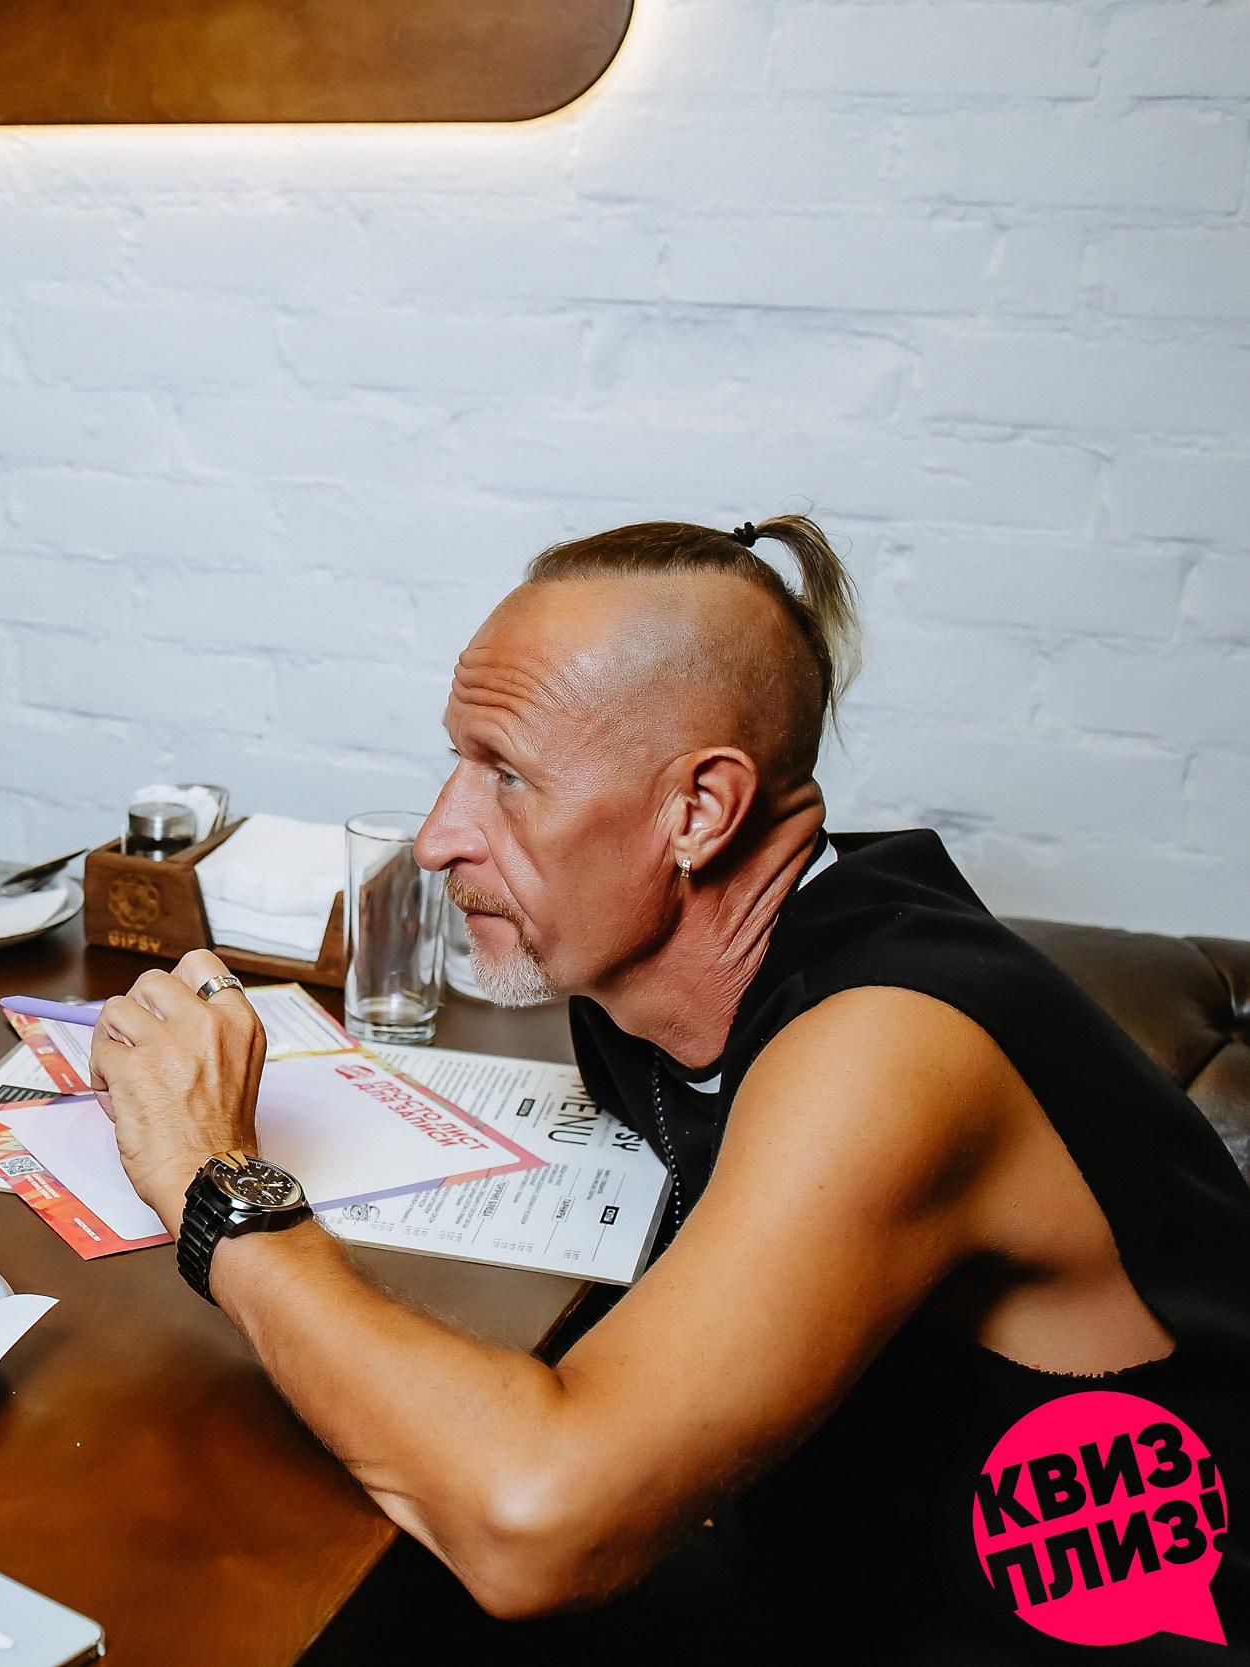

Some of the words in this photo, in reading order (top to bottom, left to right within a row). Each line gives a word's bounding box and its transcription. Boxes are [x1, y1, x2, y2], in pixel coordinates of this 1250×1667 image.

[352, 1083, 395, 1103] ДЛЯ
[388, 1104, 459, 1147] ЗАПИСИ
[372, 1080, 442, 1121] ПРОСТО
[435, 1123, 489, 1150] ЛИСТ
